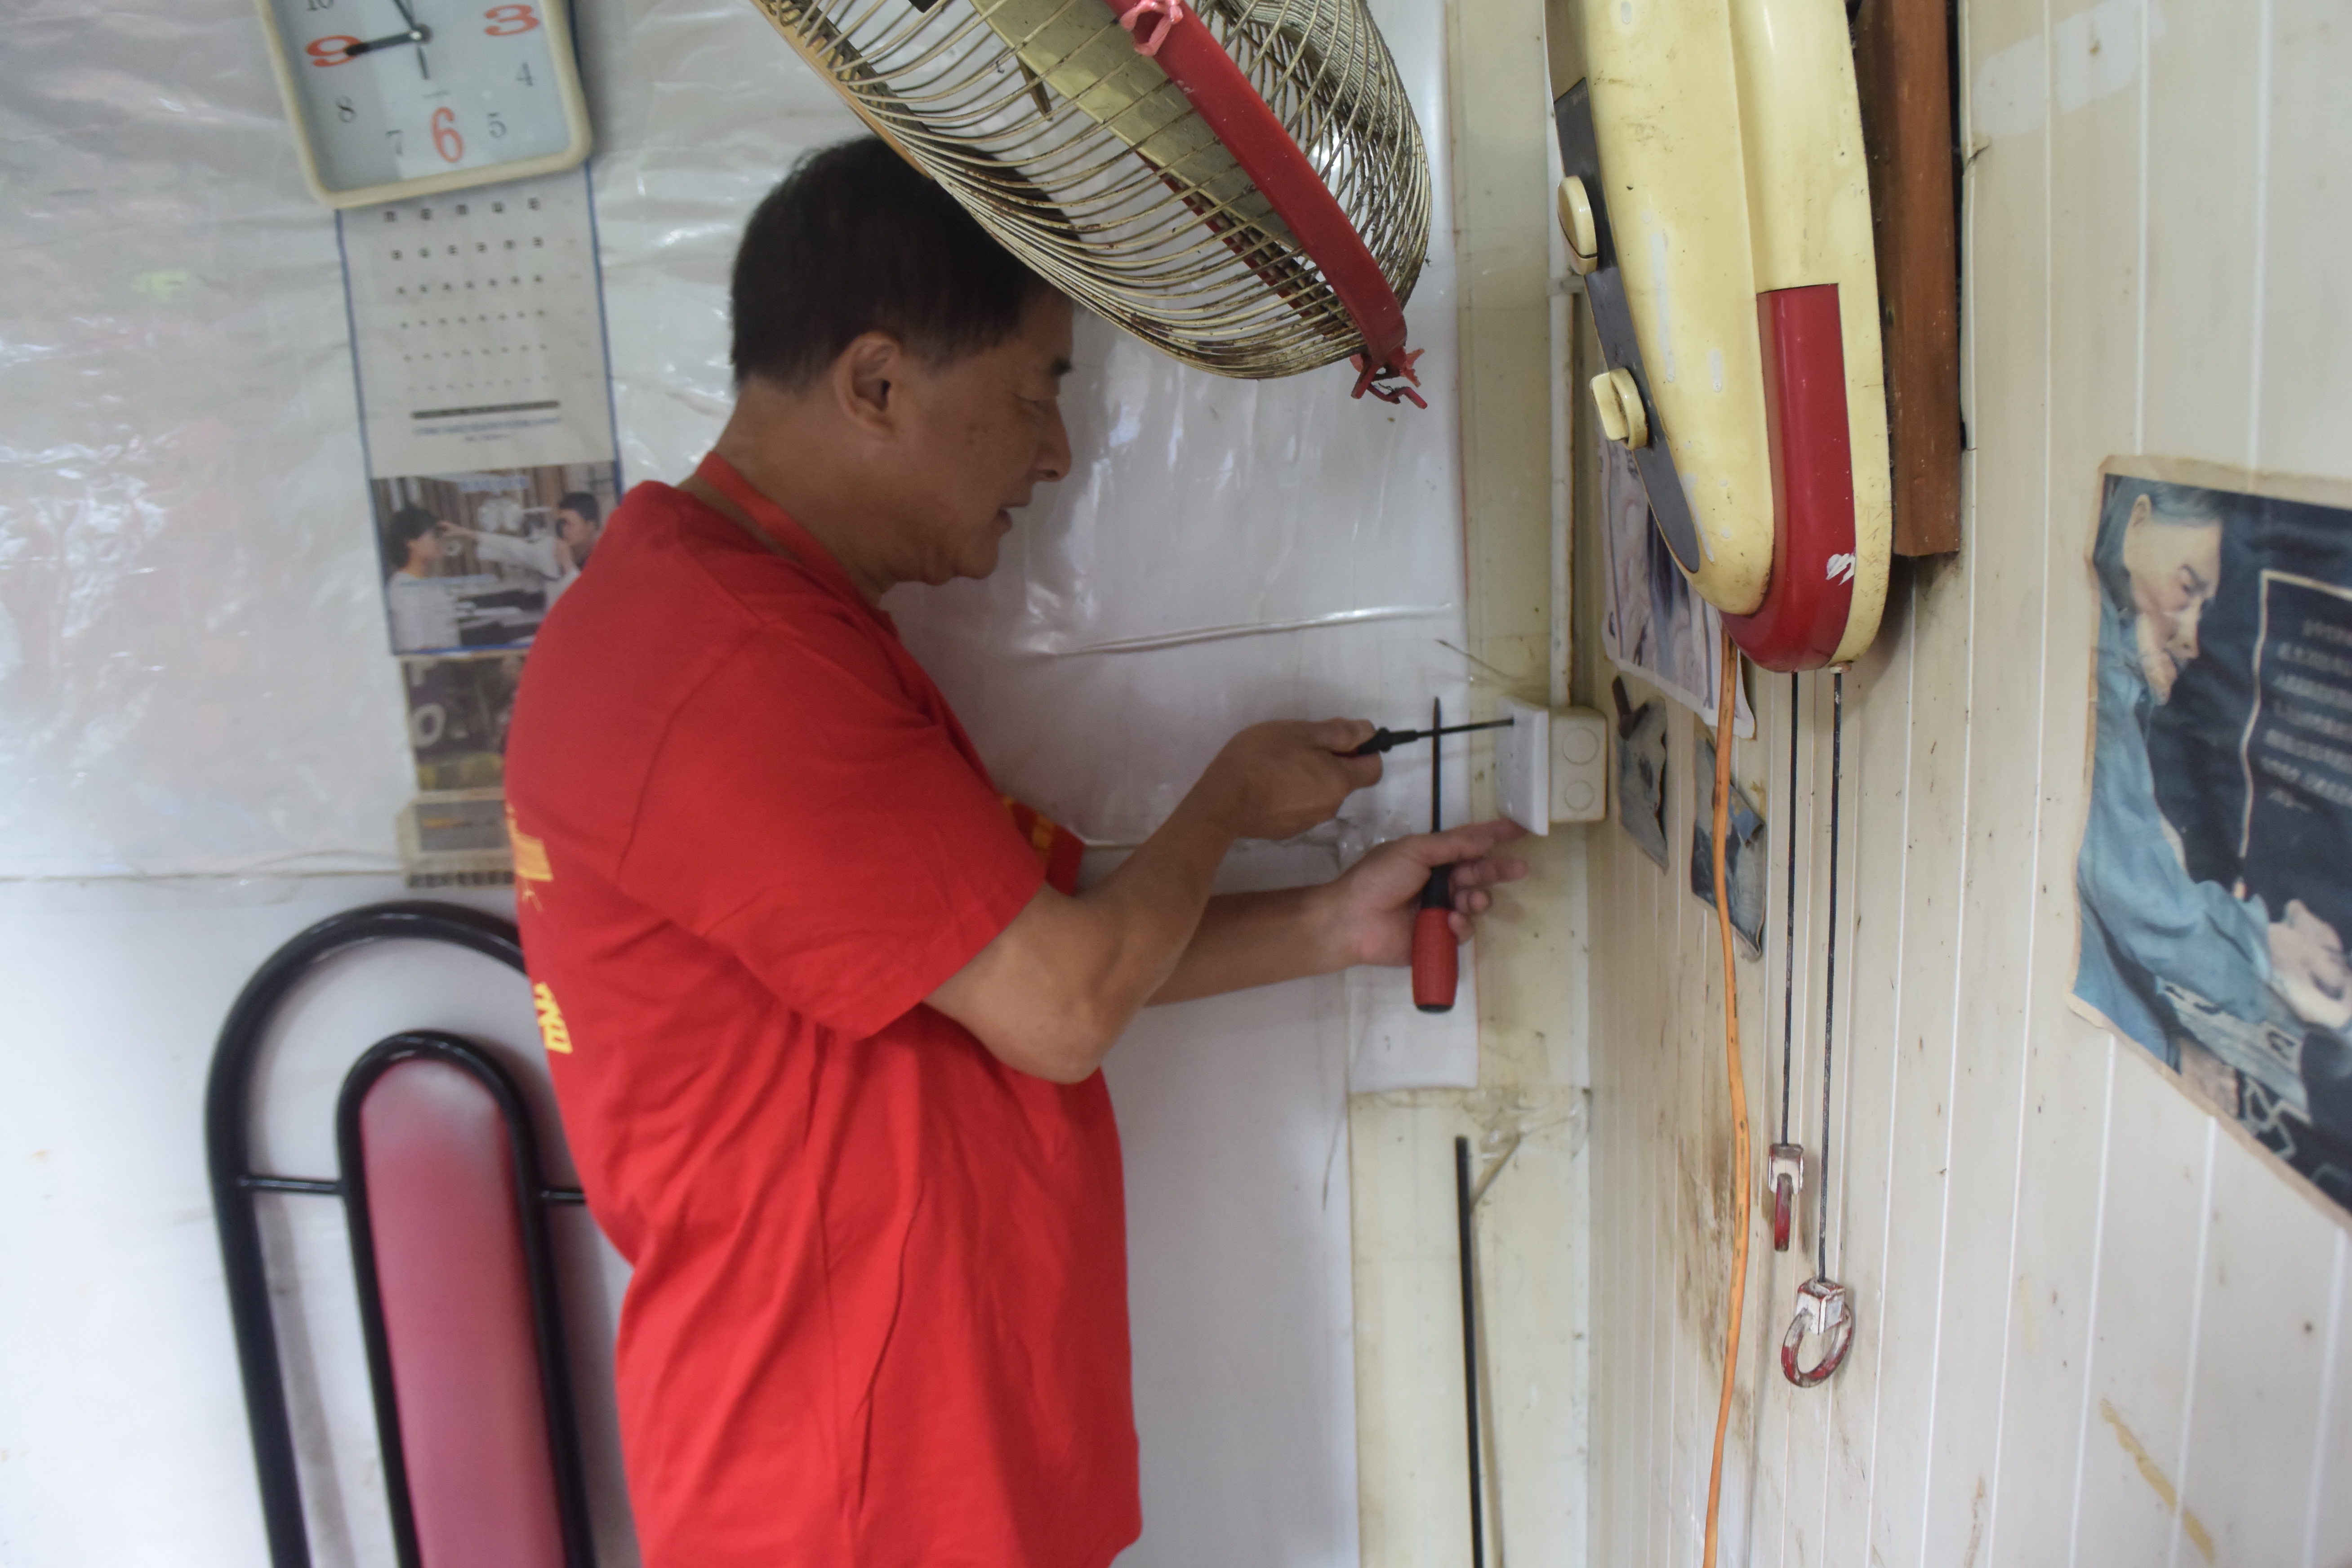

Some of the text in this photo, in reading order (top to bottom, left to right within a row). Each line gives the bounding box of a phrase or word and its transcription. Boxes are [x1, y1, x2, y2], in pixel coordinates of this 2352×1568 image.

[484, 4, 540, 36] 3
[306, 35, 362, 67] 9
[516, 61, 534, 86] 4
[335, 95, 356, 123] 8
[430, 107, 465, 163] 6
[488, 112, 508, 138] 5
[385, 129, 403, 156] 7
